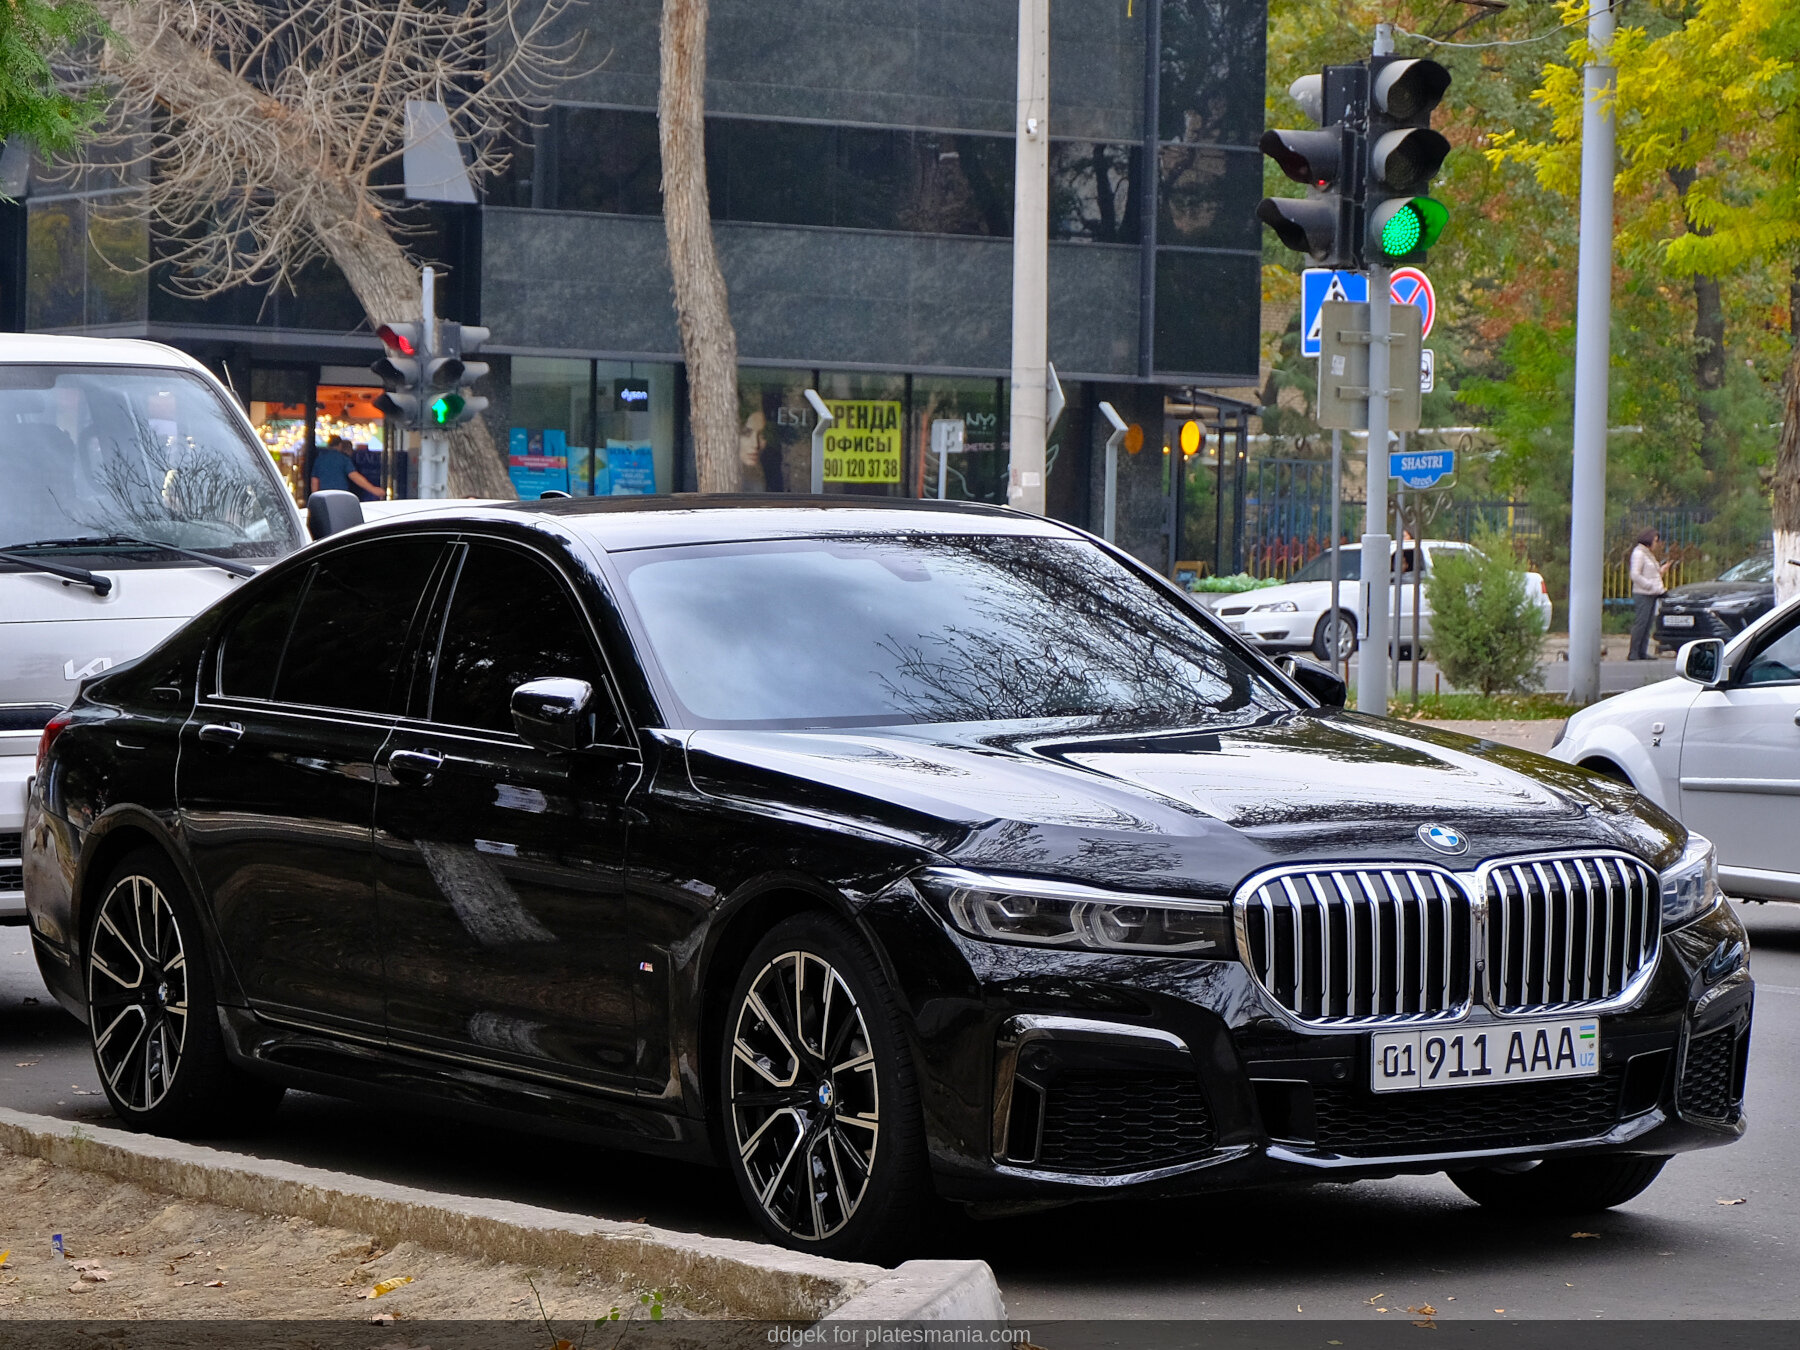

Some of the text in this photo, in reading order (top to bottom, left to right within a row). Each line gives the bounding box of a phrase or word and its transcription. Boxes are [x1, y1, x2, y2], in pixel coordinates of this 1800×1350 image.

[621, 387, 648, 403] dyson
[826, 436, 892, 453] ОФИСЫ
[845, 459, 865, 477] 120
[868, 459, 880, 478] 37
[883, 459, 898, 478] 38
[1401, 455, 1443, 471] SHASTRI
[1383, 1026, 1577, 1080] 01 911 AAA
[1579, 1052, 1595, 1067] UZ
